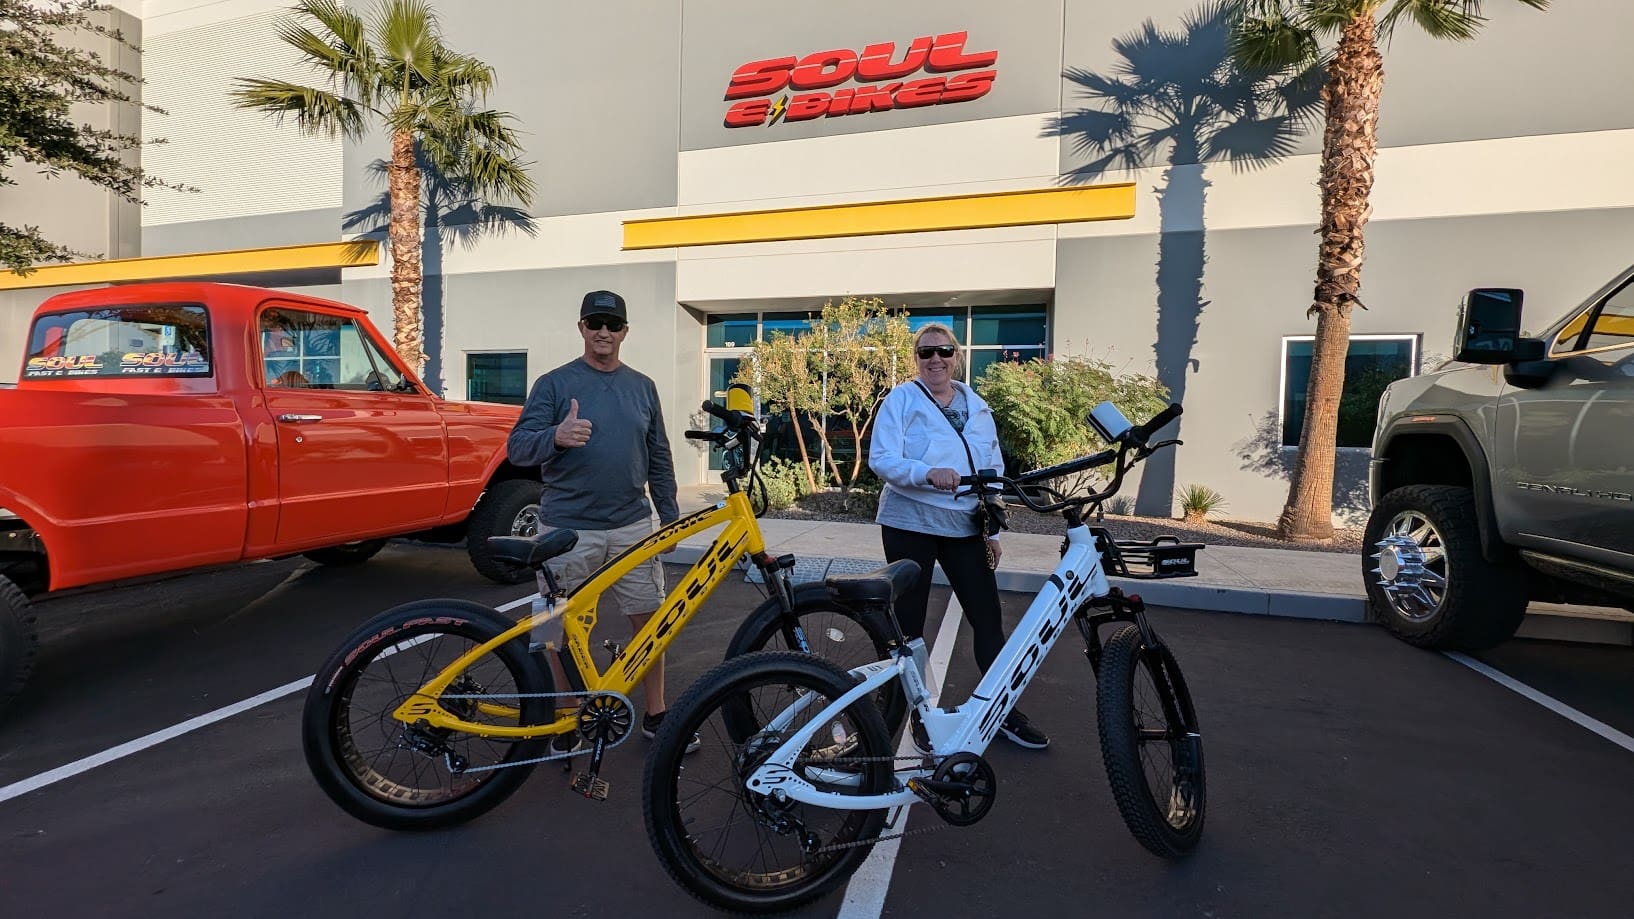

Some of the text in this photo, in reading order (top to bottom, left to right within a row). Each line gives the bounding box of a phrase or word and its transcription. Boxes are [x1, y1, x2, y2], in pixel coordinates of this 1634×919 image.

[724, 31, 998, 101] SOUL
[26, 355, 103, 370] SOUL
[120, 351, 208, 367] SOUL
[642, 514, 713, 550] SONIC
[623, 530, 748, 683] SOUL
[979, 563, 1097, 743] SOUL
